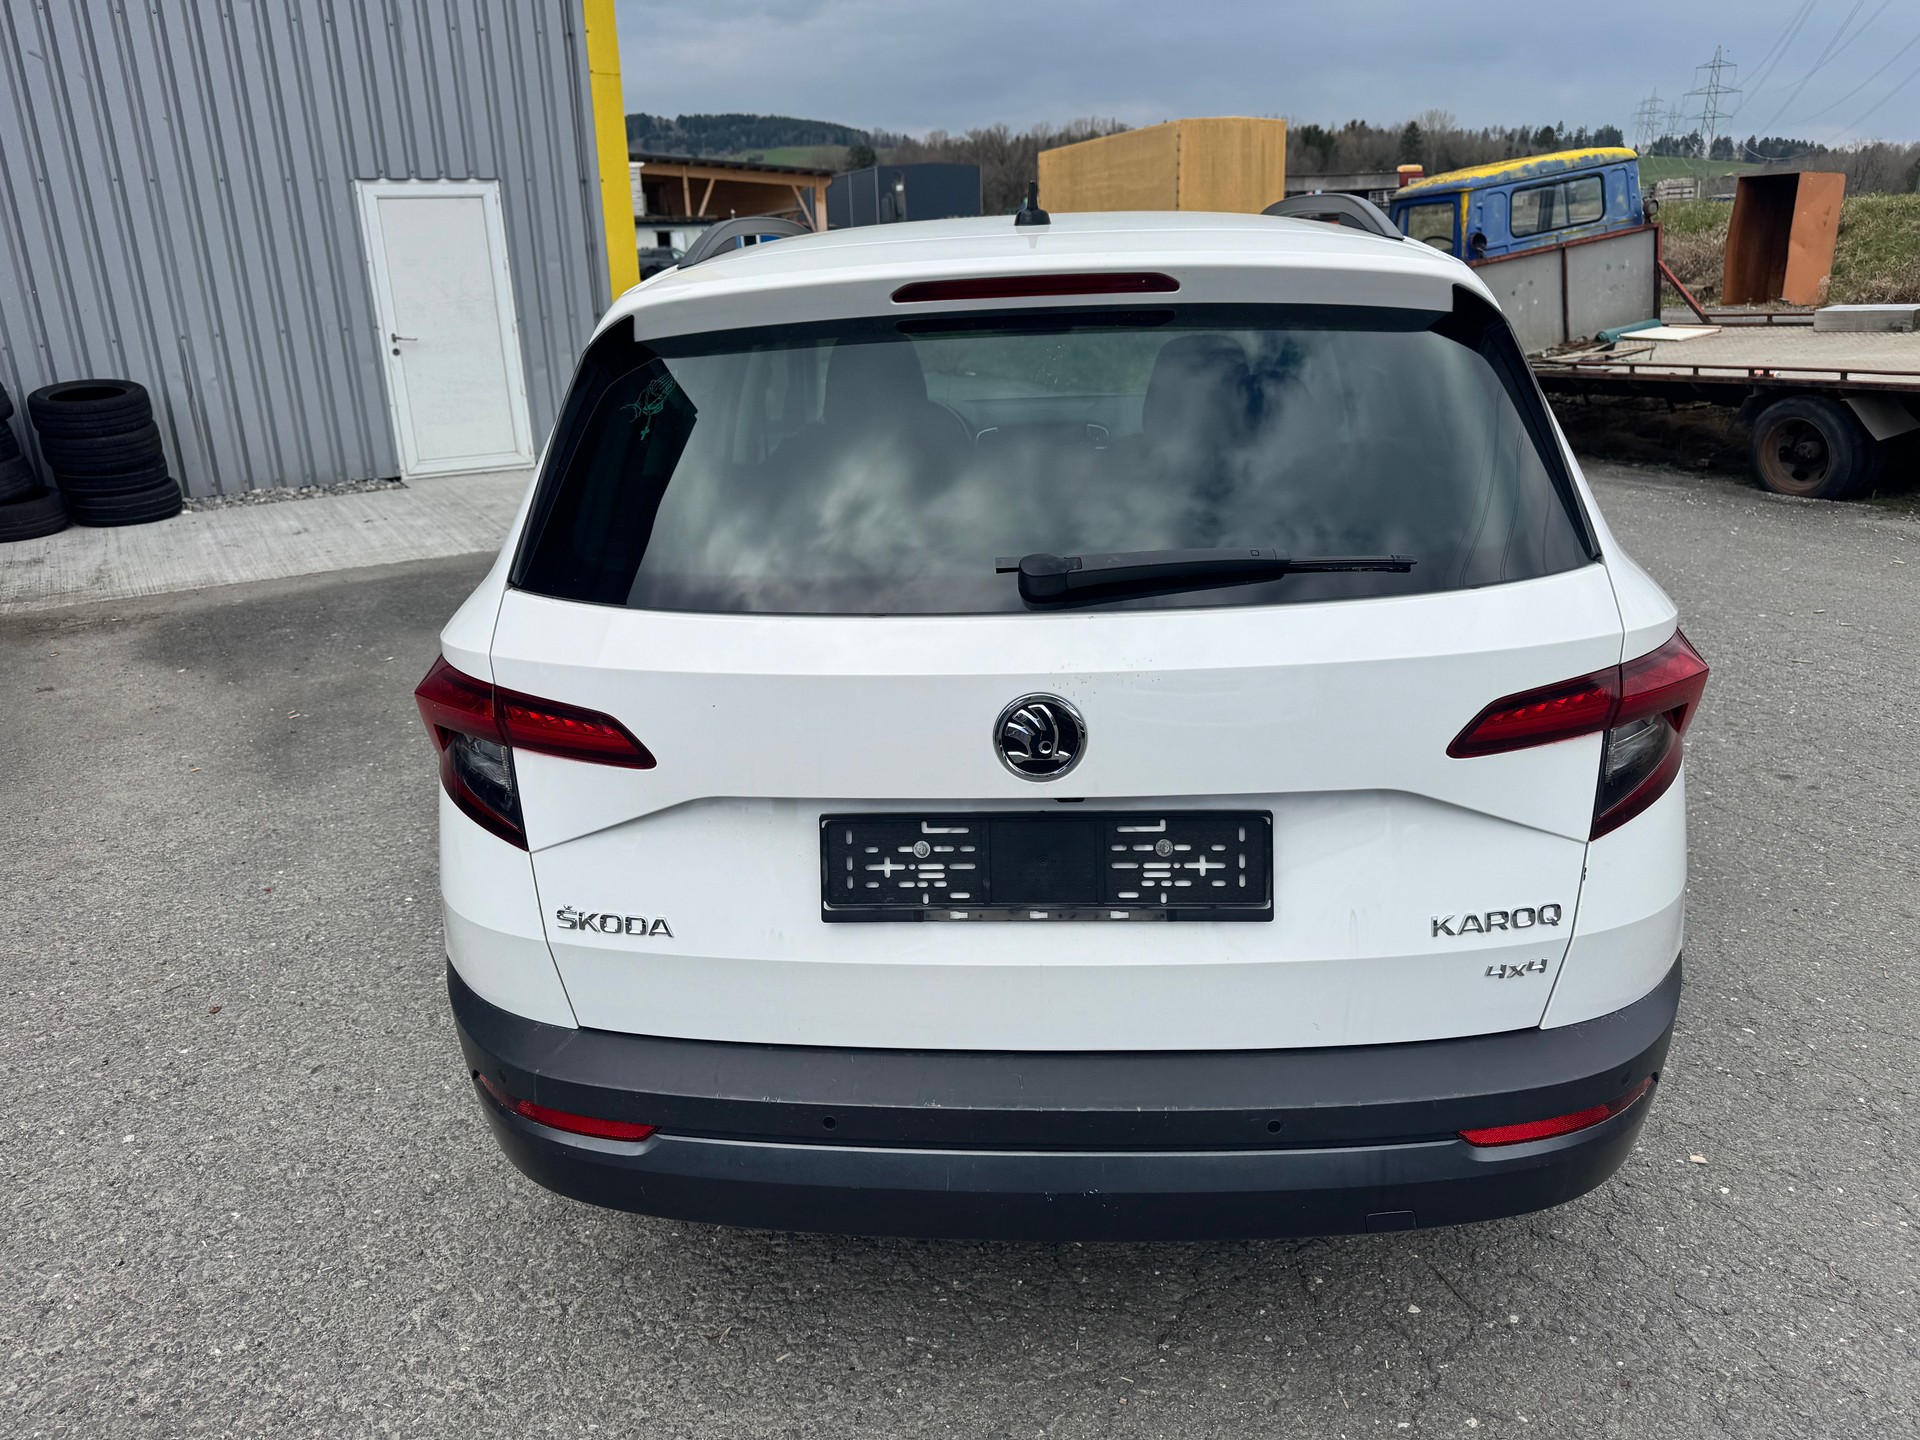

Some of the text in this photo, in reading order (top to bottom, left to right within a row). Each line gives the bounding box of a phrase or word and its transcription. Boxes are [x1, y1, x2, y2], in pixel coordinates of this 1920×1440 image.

[556, 904, 674, 938] ŠKODA
[1431, 902, 1562, 938] KAROQ
[1484, 957, 1548, 979] 4x4
